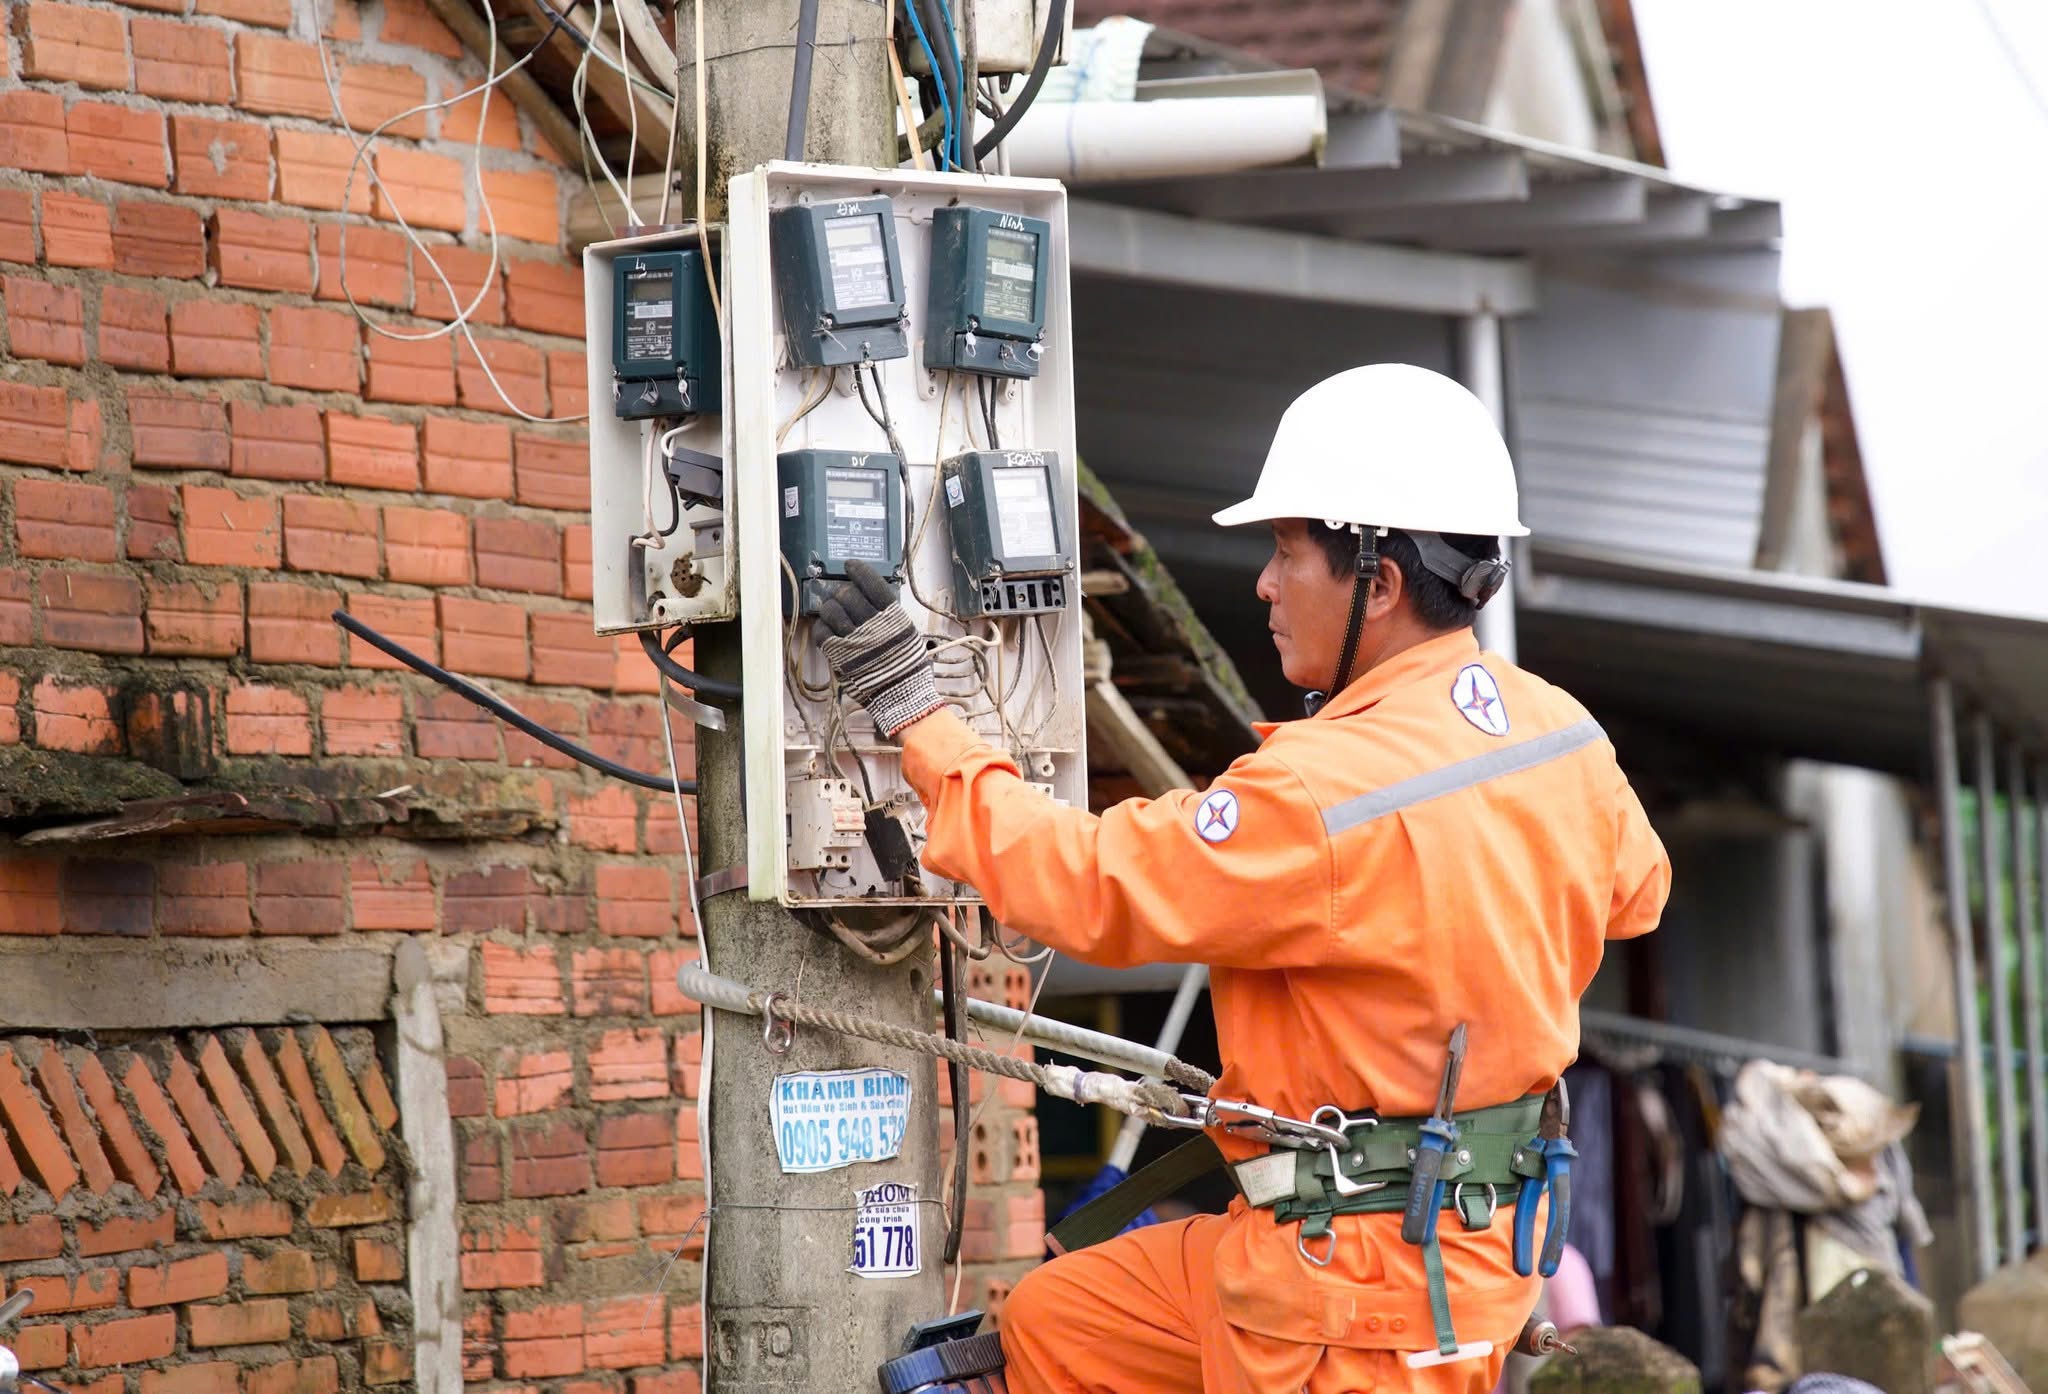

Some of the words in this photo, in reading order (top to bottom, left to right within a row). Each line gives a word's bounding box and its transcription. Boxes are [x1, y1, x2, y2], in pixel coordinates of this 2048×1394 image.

[782, 1119, 831, 1165] 0905
[837, 1116, 874, 1161] 948
[882, 1225, 914, 1267] 778
